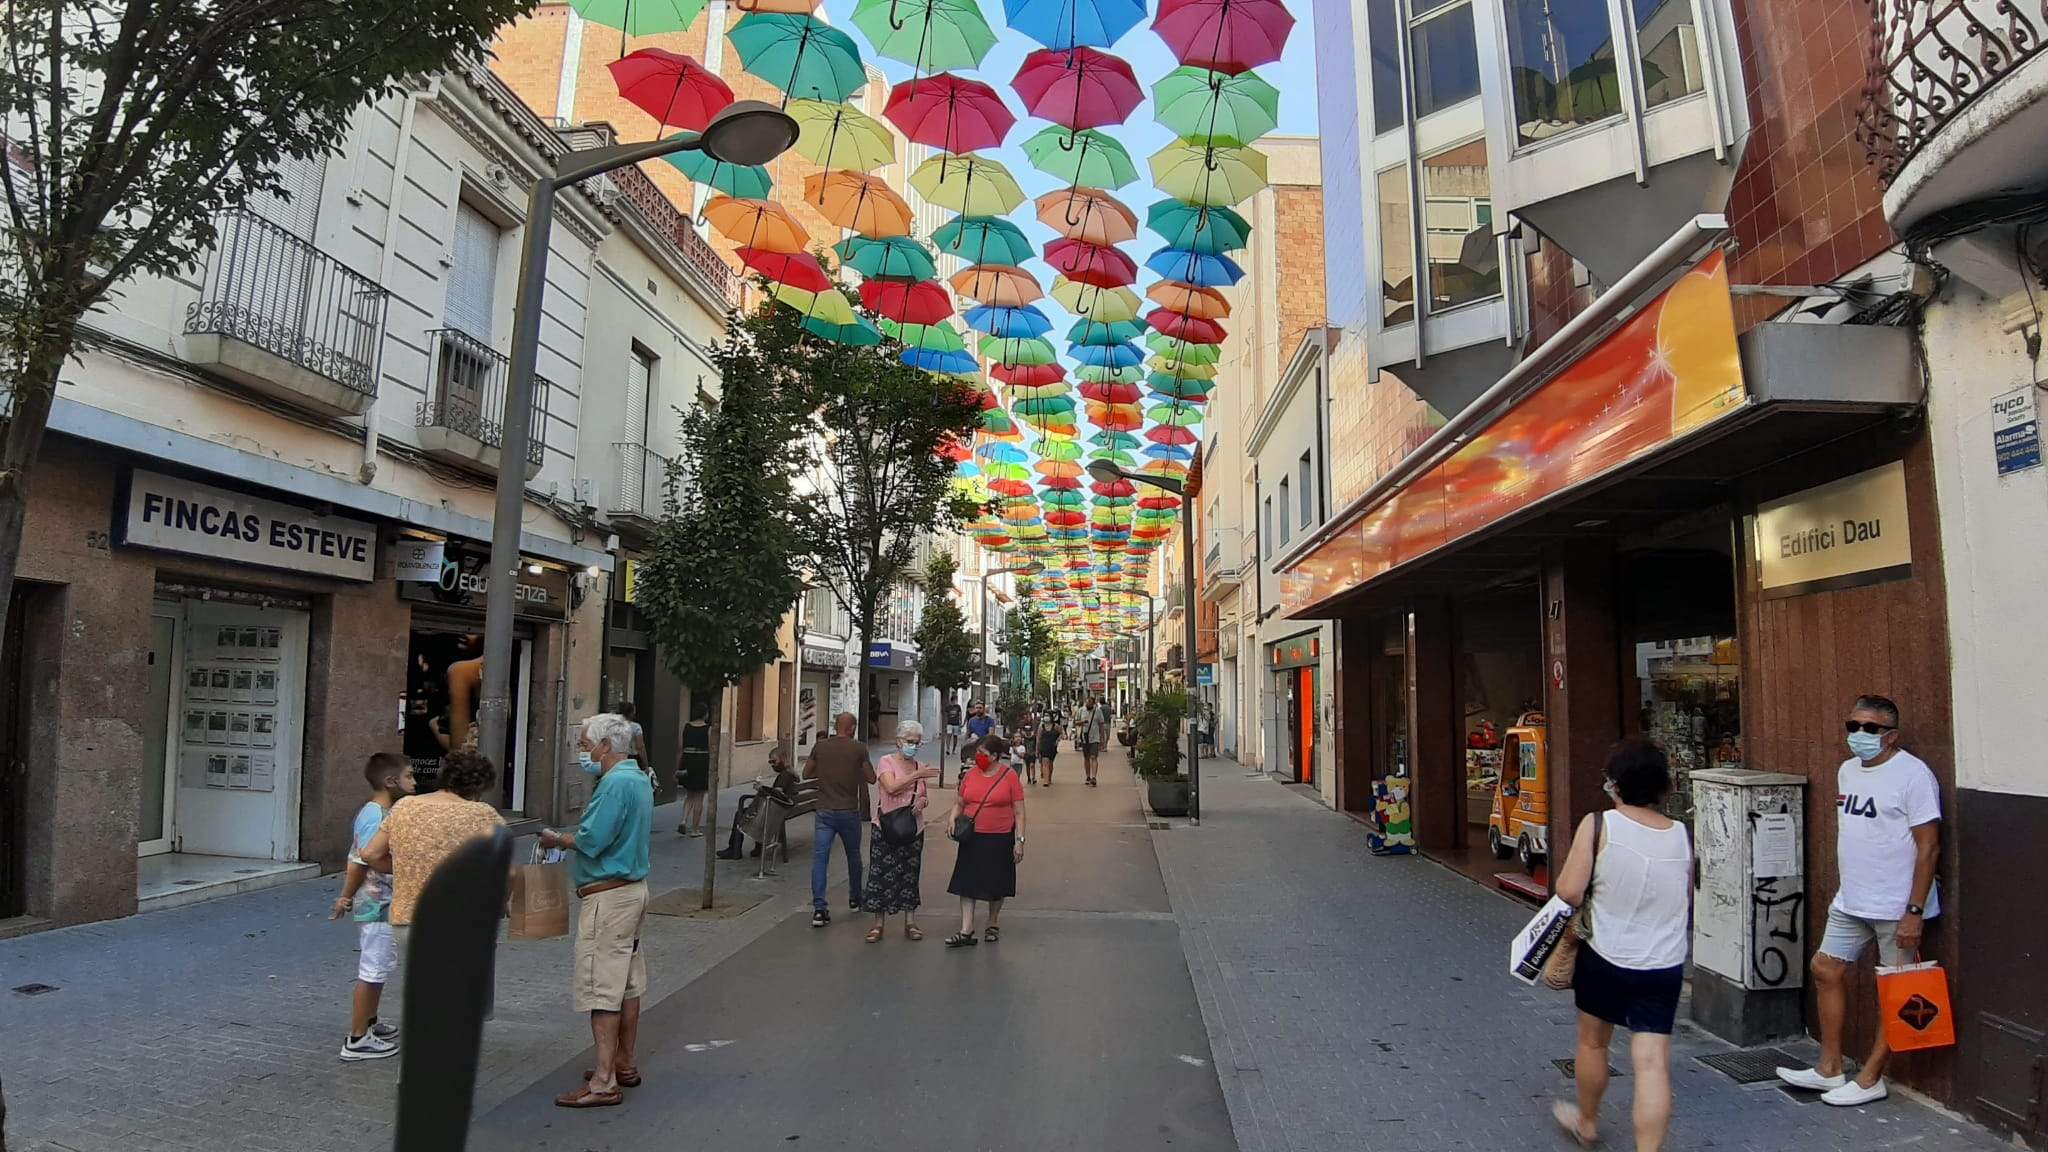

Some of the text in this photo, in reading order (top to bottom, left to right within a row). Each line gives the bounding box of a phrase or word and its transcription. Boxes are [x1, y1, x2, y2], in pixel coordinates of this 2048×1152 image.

[1993, 396, 2024, 414] tyco
[1996, 431, 2026, 445] Alarma
[143, 492, 368, 562] FINCAS ESTEVE
[1780, 519, 1881, 559] Edifici Dau
[869, 650, 890, 659] BBVA
